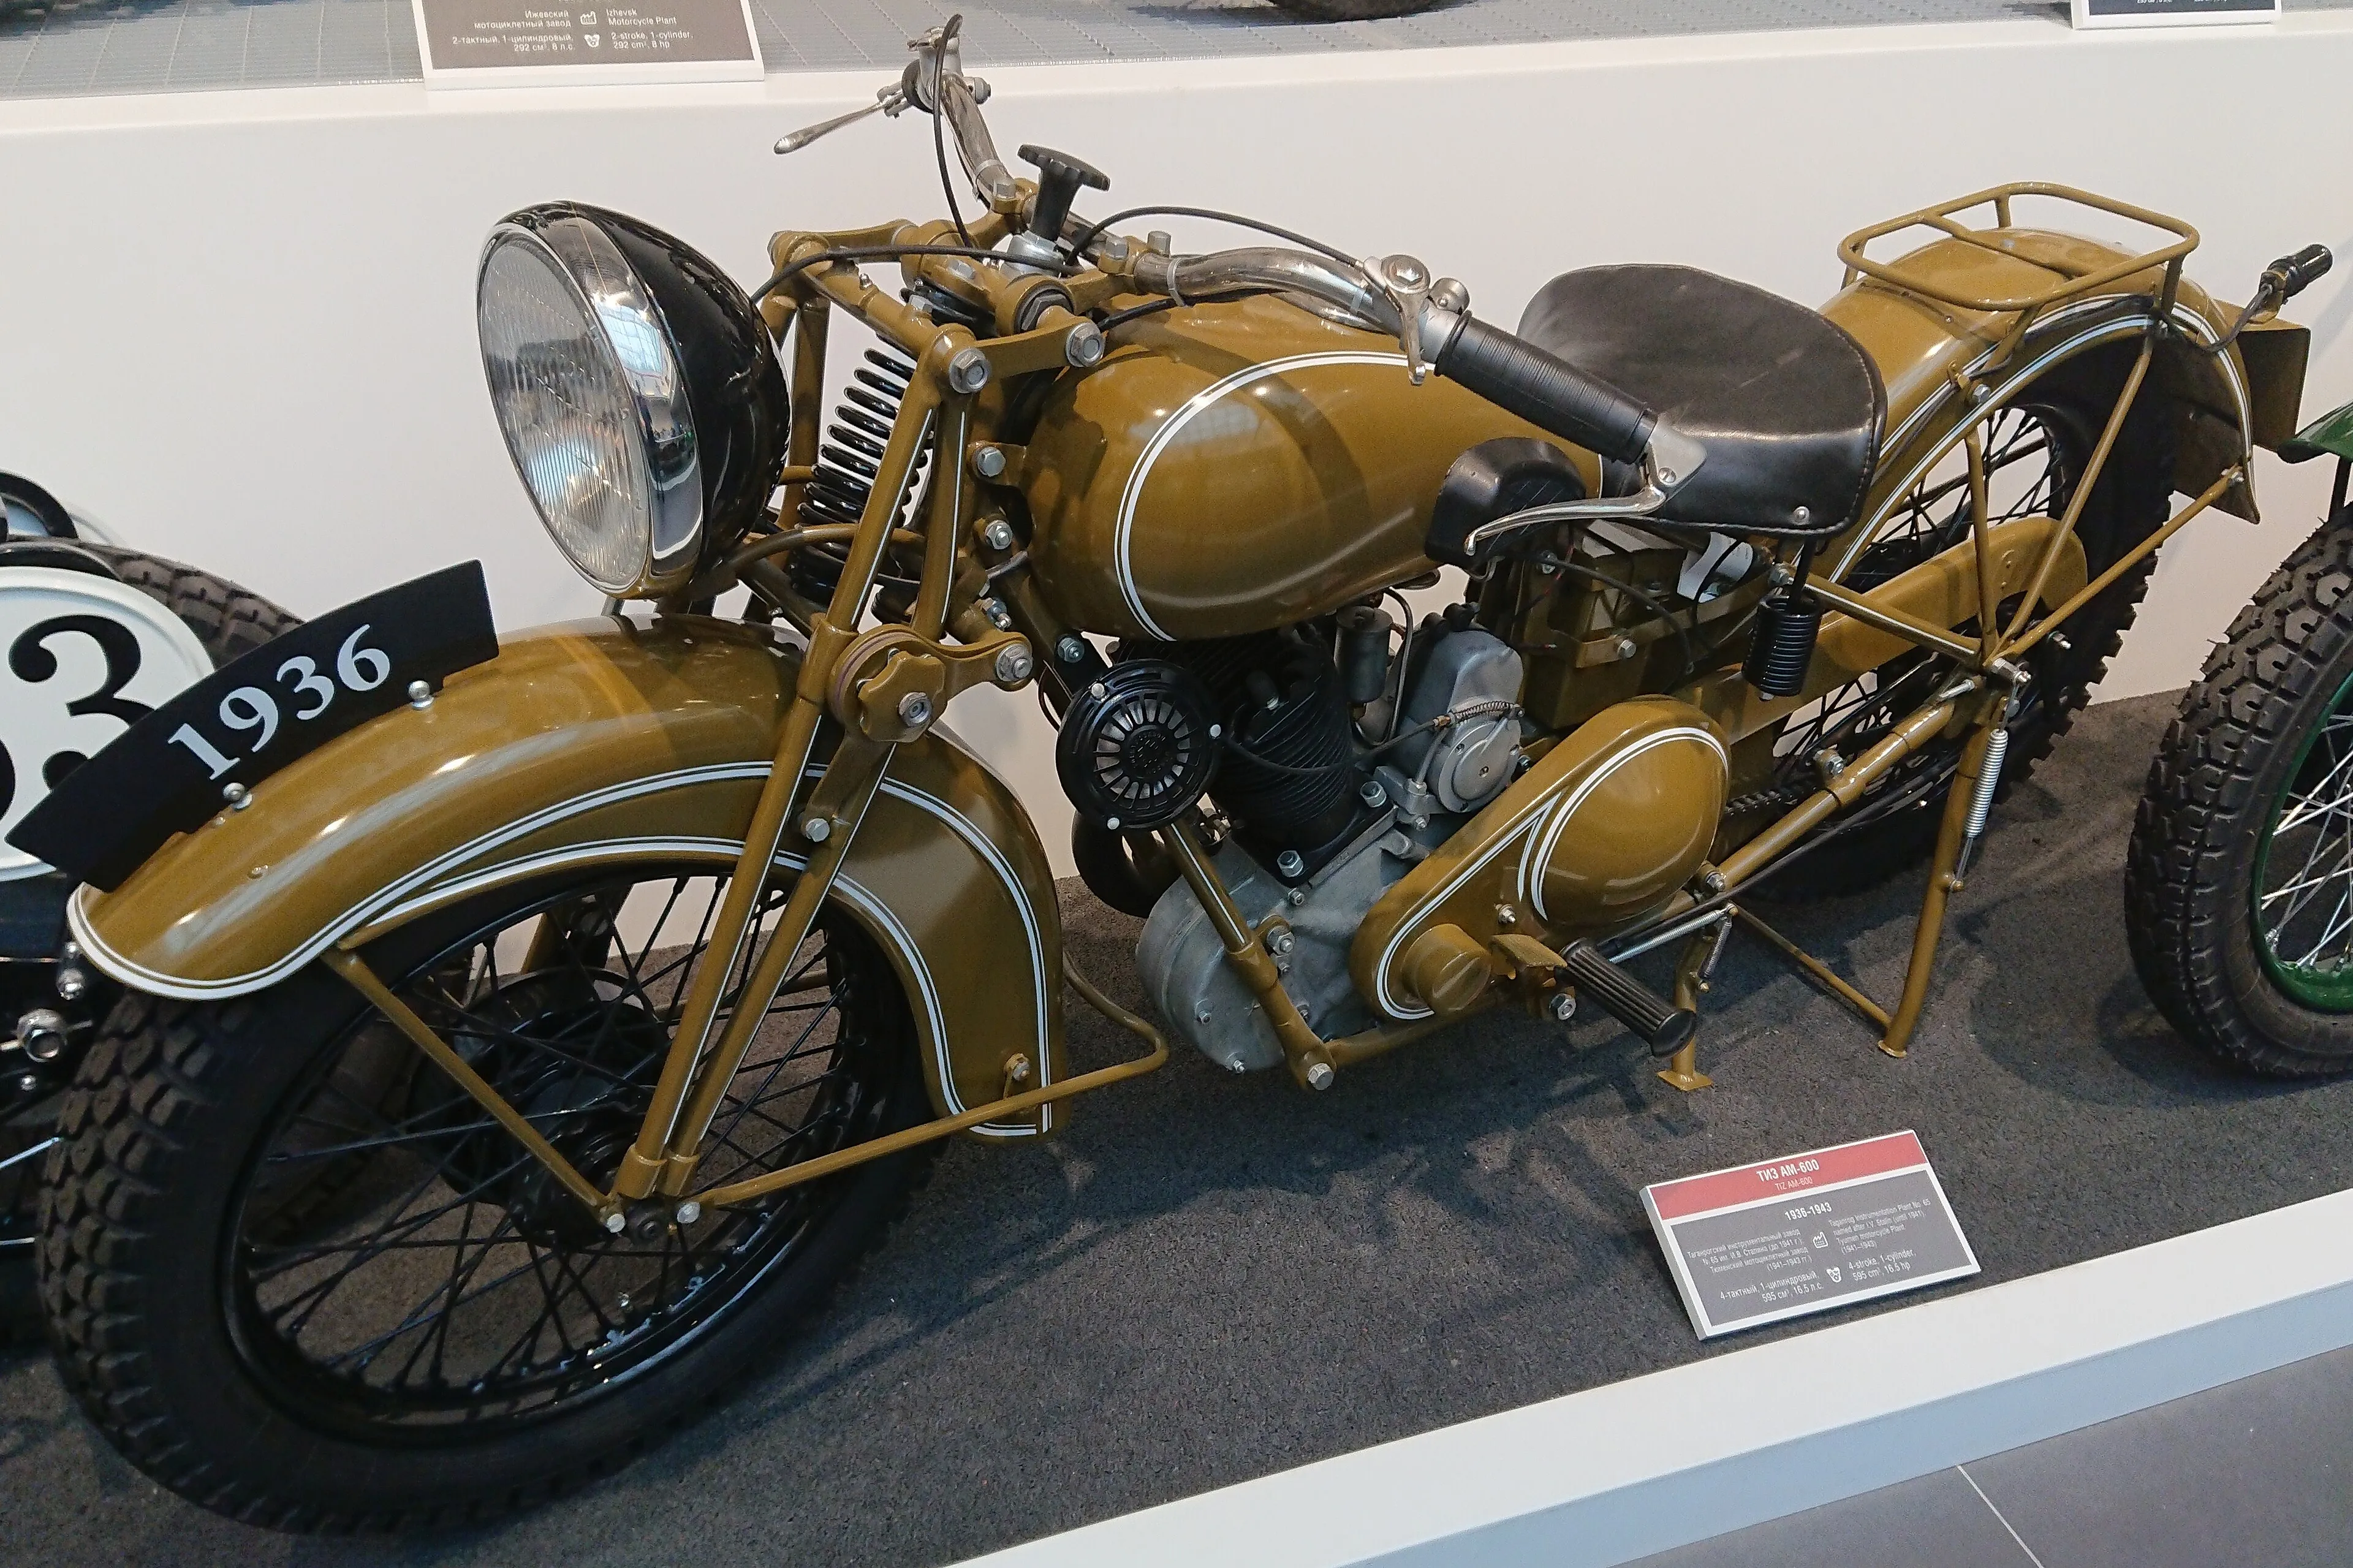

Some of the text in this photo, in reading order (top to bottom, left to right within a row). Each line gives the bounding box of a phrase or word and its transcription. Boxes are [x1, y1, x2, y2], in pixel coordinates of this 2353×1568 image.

[525, 10, 569, 19] Ижевский
[606, 8, 637, 17] Izhevsk
[474, 20, 544, 30] мотоциклетный
[608, 16, 678, 26] Motorcycle Plant
[452, 36, 500, 44] 2-тактный,
[611, 31, 694, 40] 2-stroke, 1-cylinder,
[613, 40, 629, 49] 292
[659, 40, 670, 49] hp
[167, 624, 391, 781] 1936
[1756, 1159, 1820, 1182] ТИЗ АМ-600
[1775, 1176, 1813, 1191] TIZ AM-600
[1784, 1202, 1832, 1221] 1936-1943
[1897, 1203, 1912, 1212] Plant
[1783, 1229, 1802, 1238] завод
[1743, 1246, 1768, 1256] Сталина
[1779, 1238, 1794, 1248] 1941
[1710, 1246, 1809, 1274] Тюменский мотоциклетный завод
[1849, 1249, 1917, 1270] 4-stroke, 1-cylinder,
[1852, 1270, 1867, 1281] 595
[1900, 1261, 1911, 1271] hp
[1720, 1270, 1820, 1300] 4-тактный, 1-цилиндровый,
[1762, 1292, 1777, 1302] 595
[1794, 1284, 1809, 1295] 16,5
